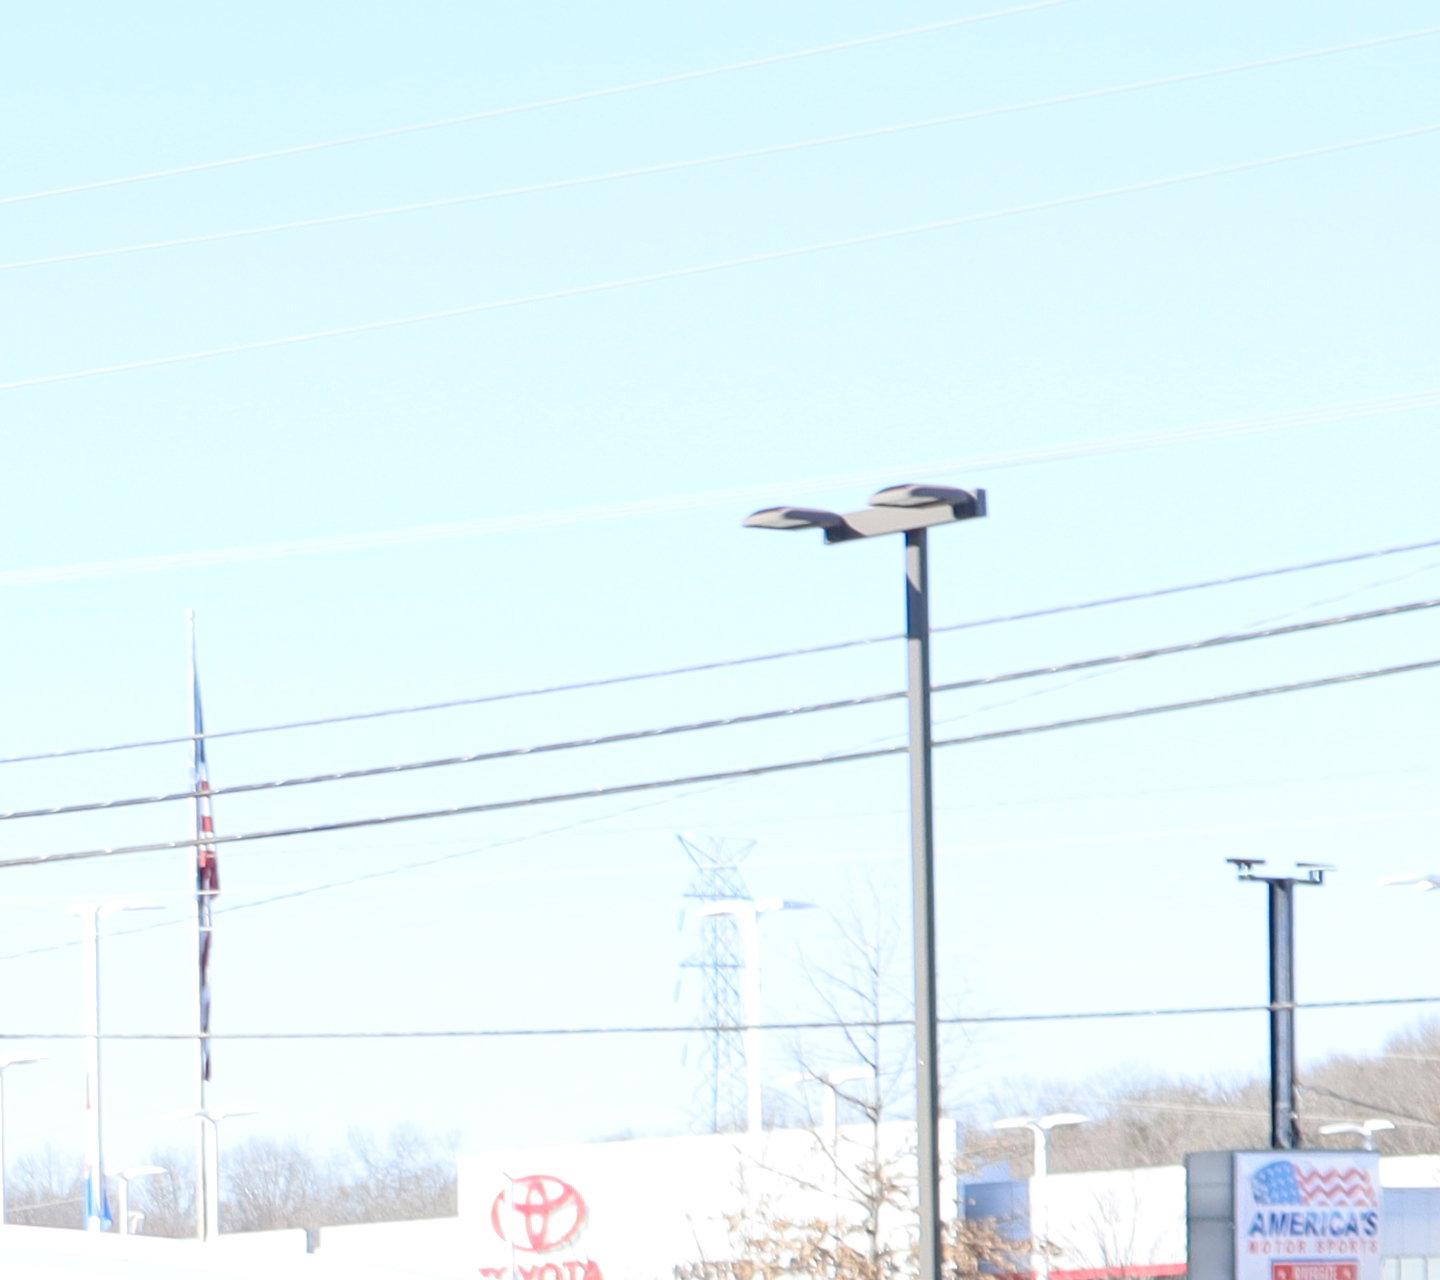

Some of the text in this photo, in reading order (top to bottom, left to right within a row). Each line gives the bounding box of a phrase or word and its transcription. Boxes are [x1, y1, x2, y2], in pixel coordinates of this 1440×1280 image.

[1247, 1210, 1379, 1237] AMERICA'S
[1248, 1239, 1379, 1255] MOTOR SPORTS
